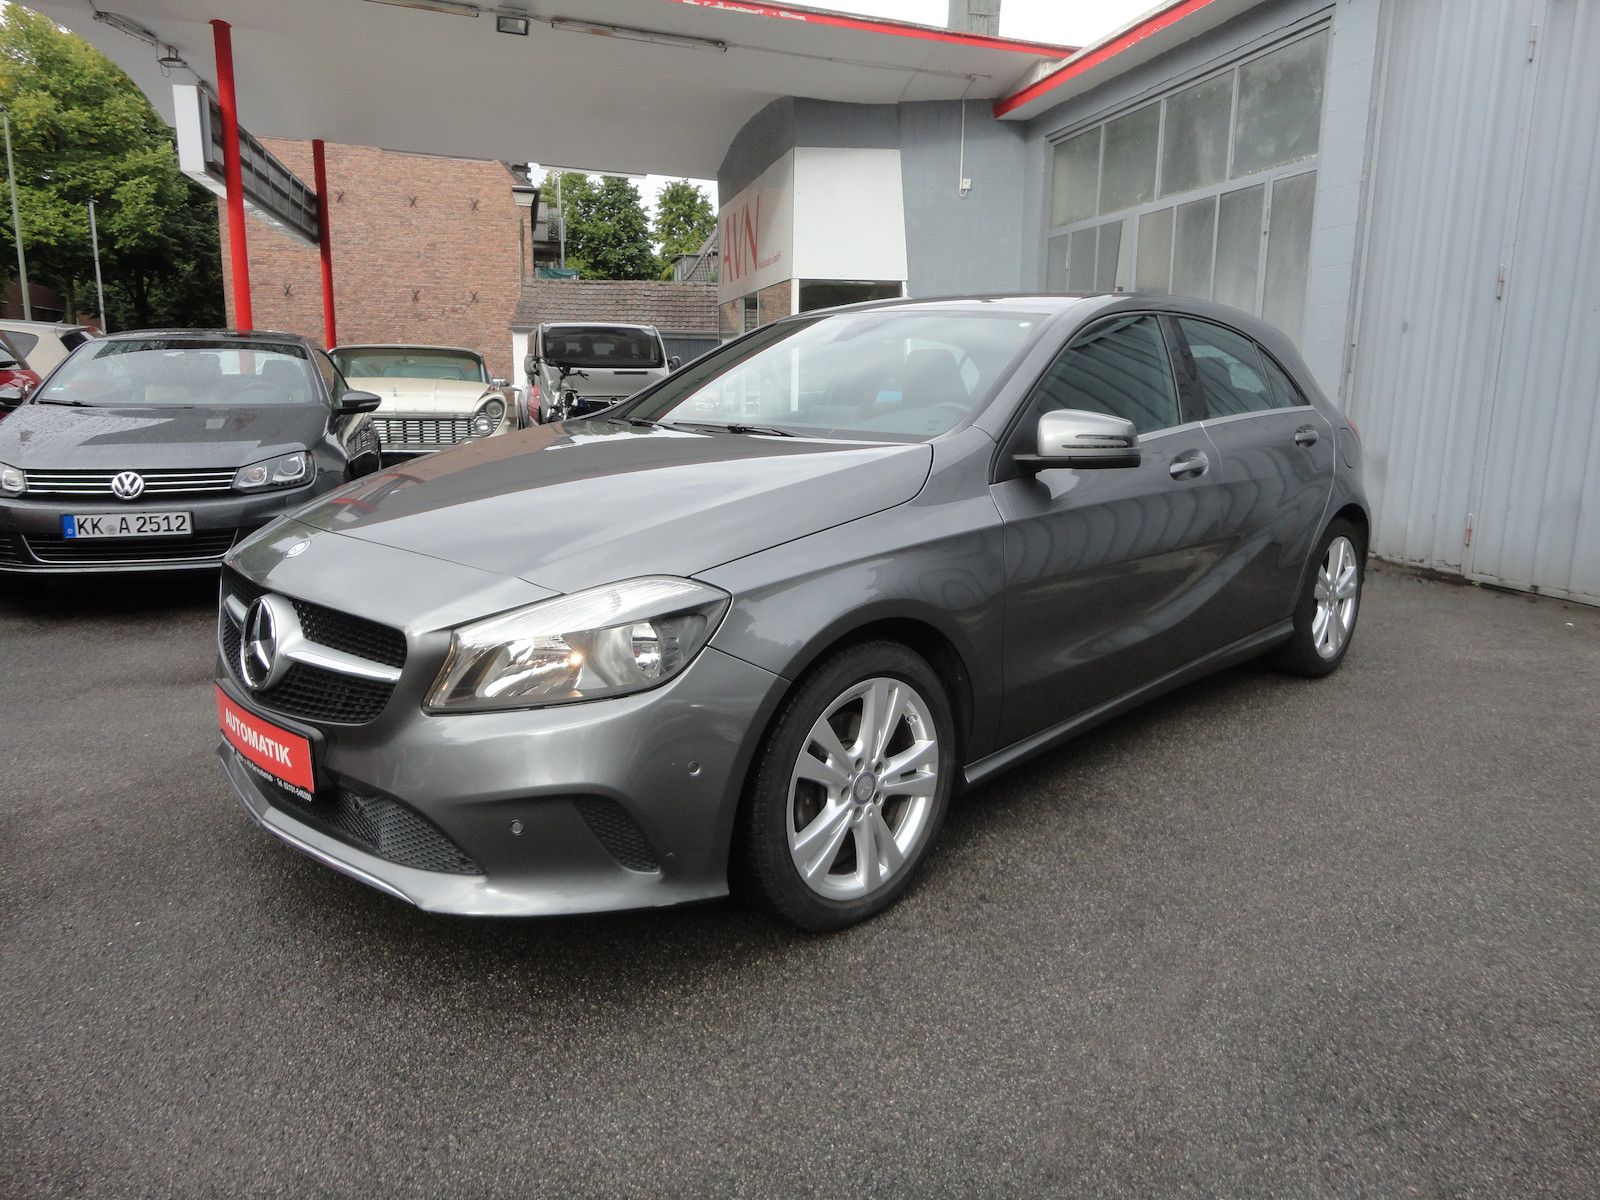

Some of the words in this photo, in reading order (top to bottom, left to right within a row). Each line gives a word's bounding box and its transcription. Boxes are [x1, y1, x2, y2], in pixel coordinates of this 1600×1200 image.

[722, 195, 760, 285] AVN
[77, 517, 104, 535] KK
[119, 516, 131, 534] A
[136, 515, 187, 533] 2512
[225, 708, 292, 767] AUTOMATIK
